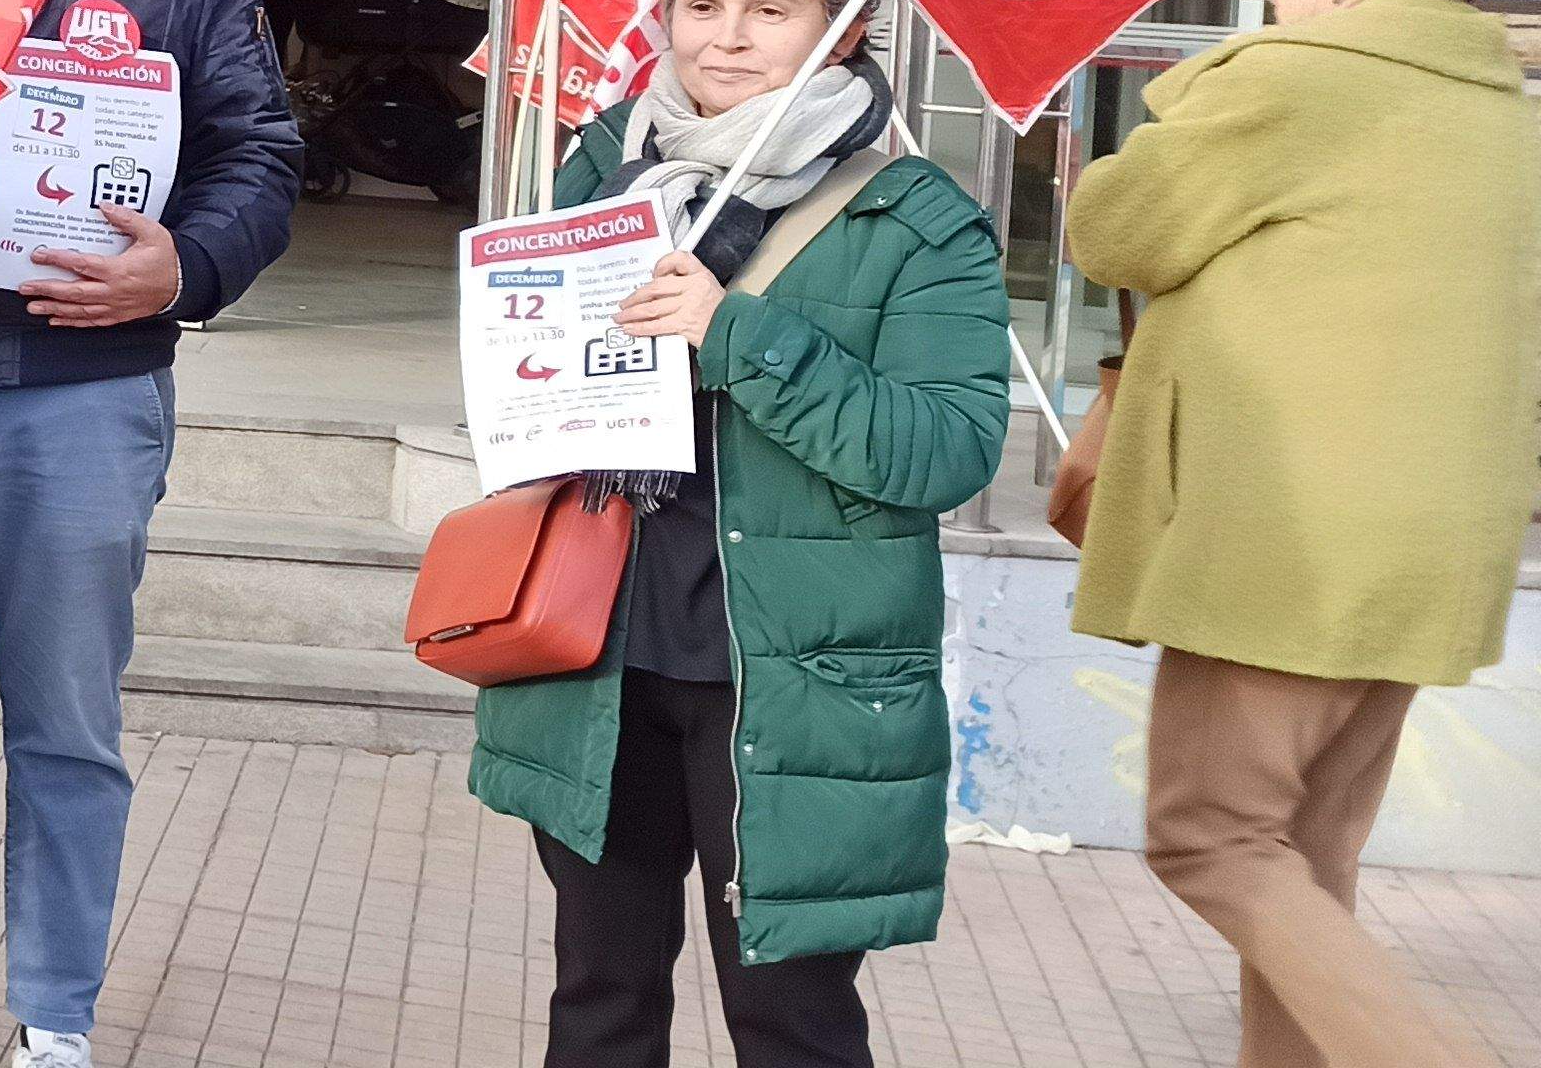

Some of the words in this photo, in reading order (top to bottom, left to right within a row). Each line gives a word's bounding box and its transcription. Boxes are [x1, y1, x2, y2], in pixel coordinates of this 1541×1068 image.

[69, 6, 129, 43] UGT
[26, 86, 80, 106] DECEMBRO
[30, 107, 68, 138] 12
[12, 144, 25, 153] de
[28, 145, 40, 155] 11
[43, 148, 49, 156] a
[483, 213, 645, 257] CONCENTRACIÓN
[494, 274, 558, 285] DECEMBRO
[503, 293, 546, 321] 12
[607, 418, 635, 429] UGT
